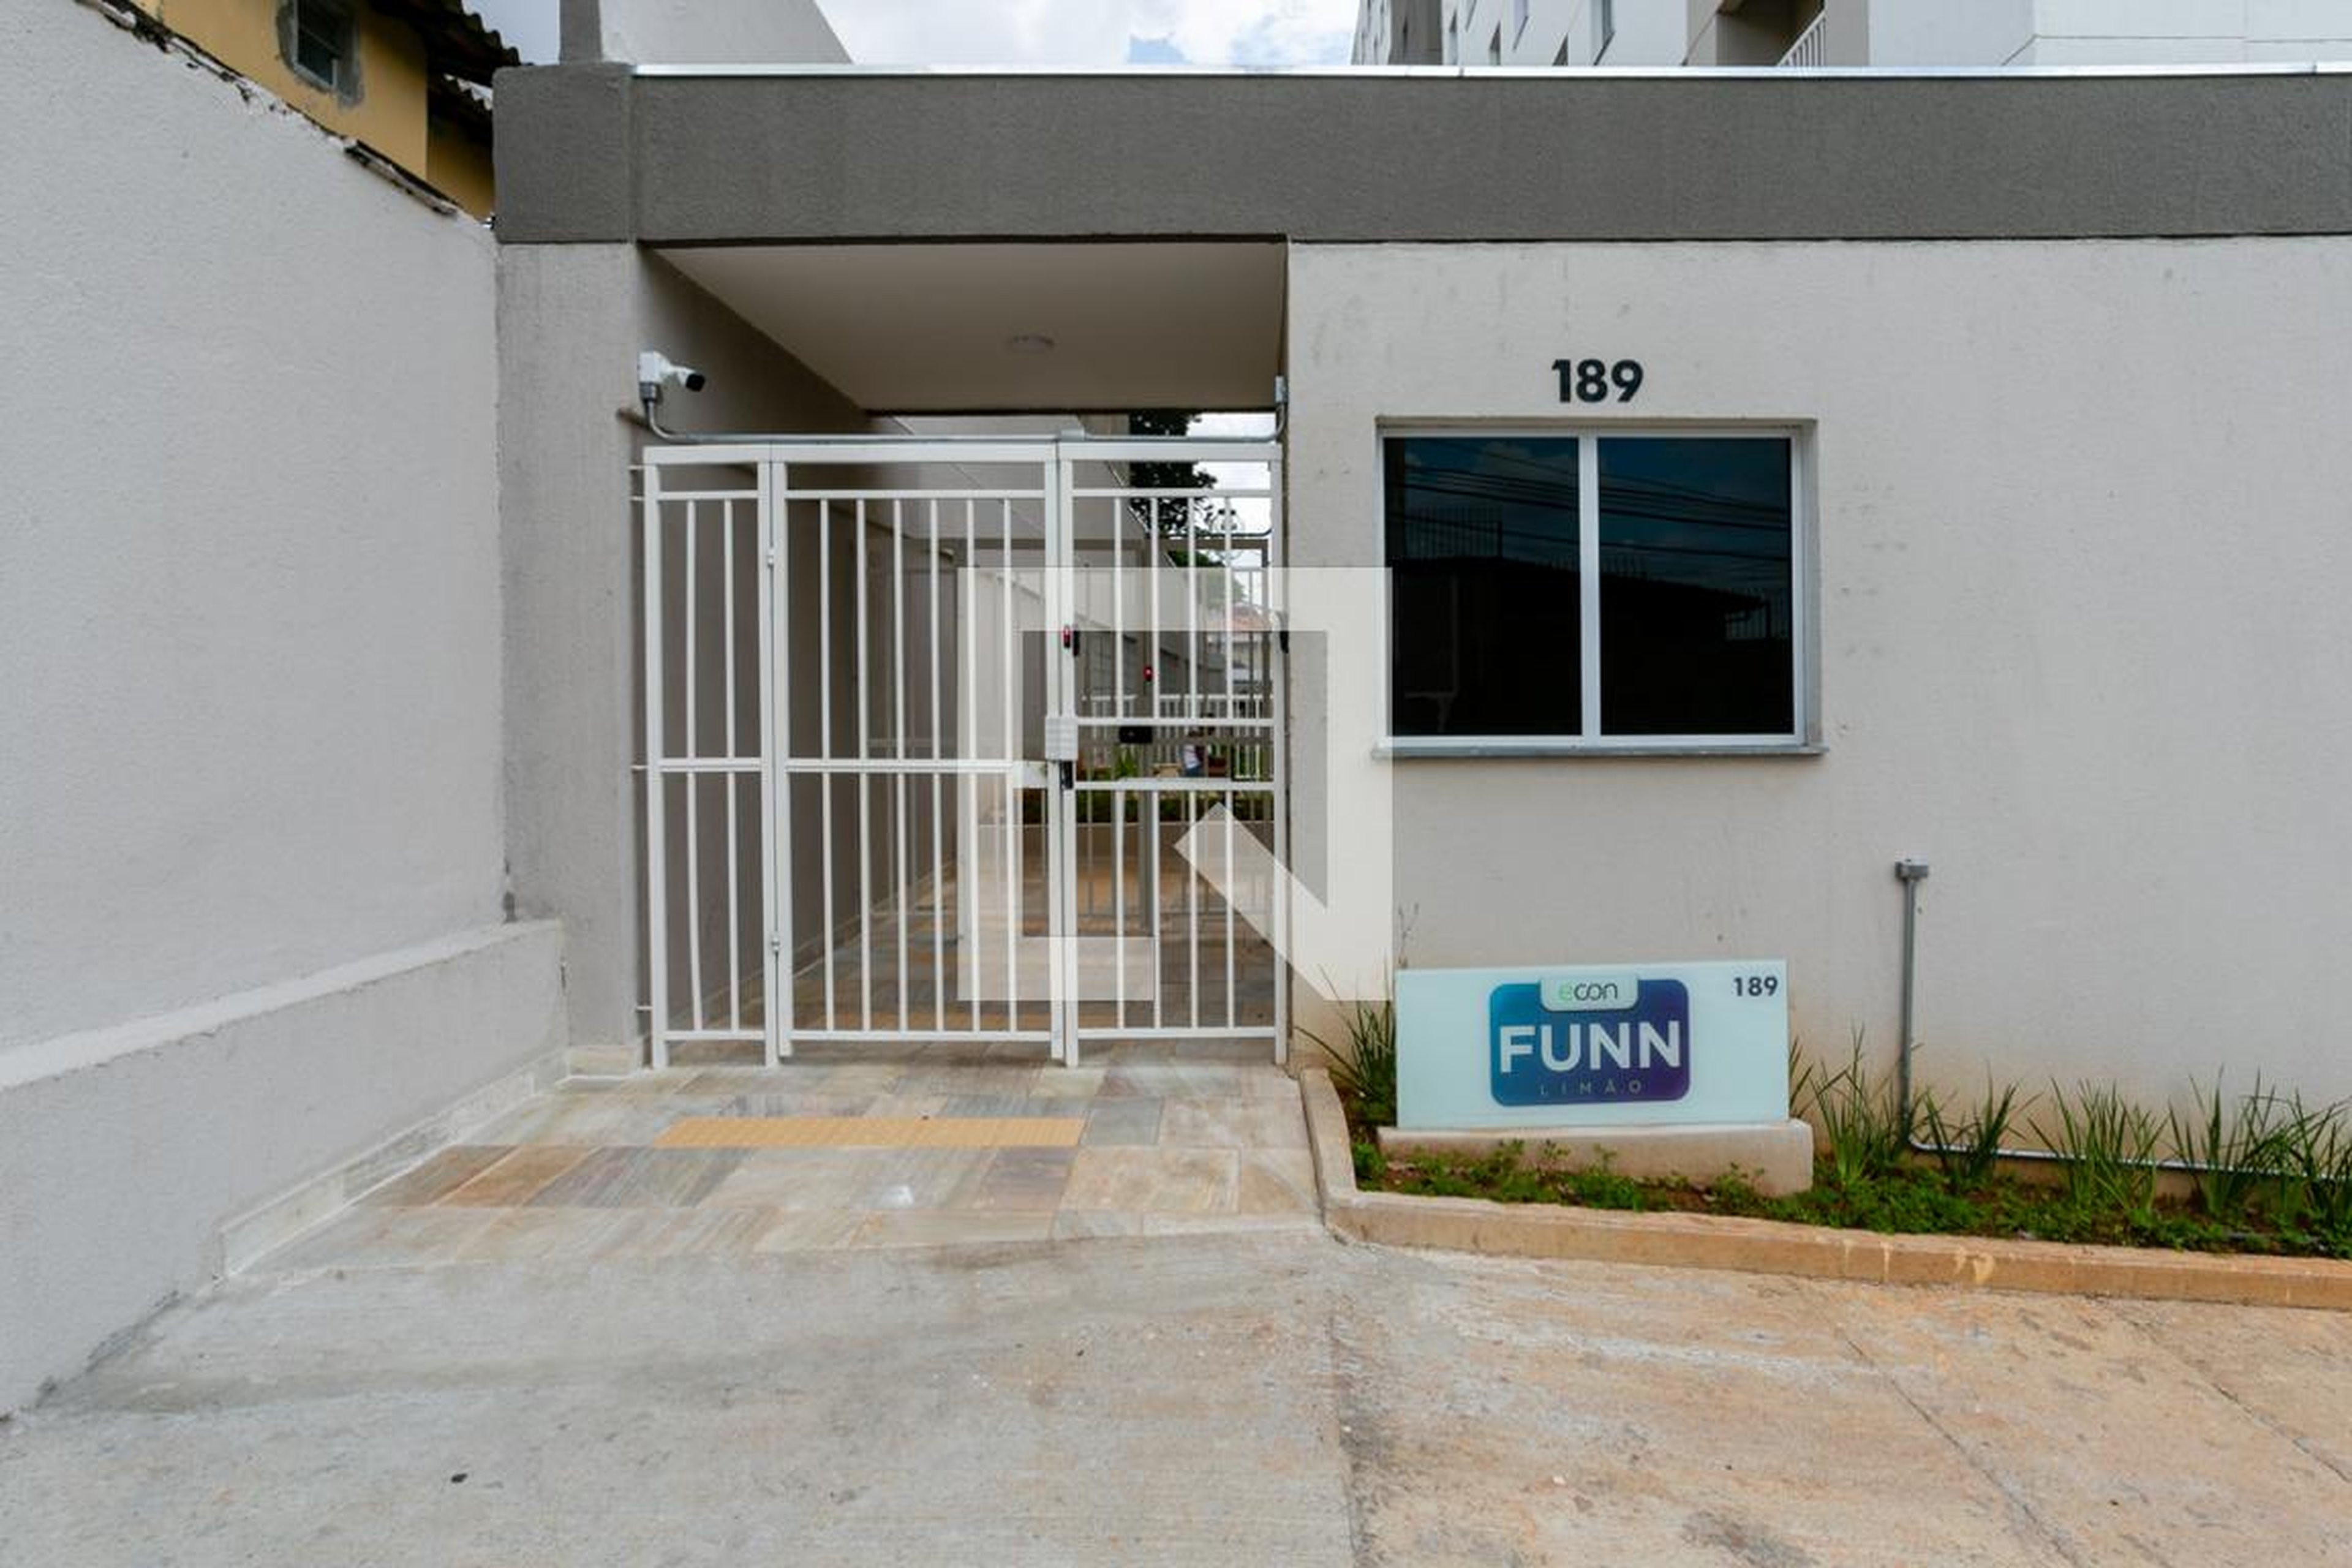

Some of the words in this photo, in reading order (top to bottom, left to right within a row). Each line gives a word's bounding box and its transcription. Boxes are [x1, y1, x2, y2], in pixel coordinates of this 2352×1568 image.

[1551, 359, 1643, 402] 189
[1559, 982, 1618, 1001] econ
[1733, 976, 1778, 997] 189
[1501, 1020, 1681, 1072] FUNN
[1540, 1079, 1642, 1095] LIMÃO
